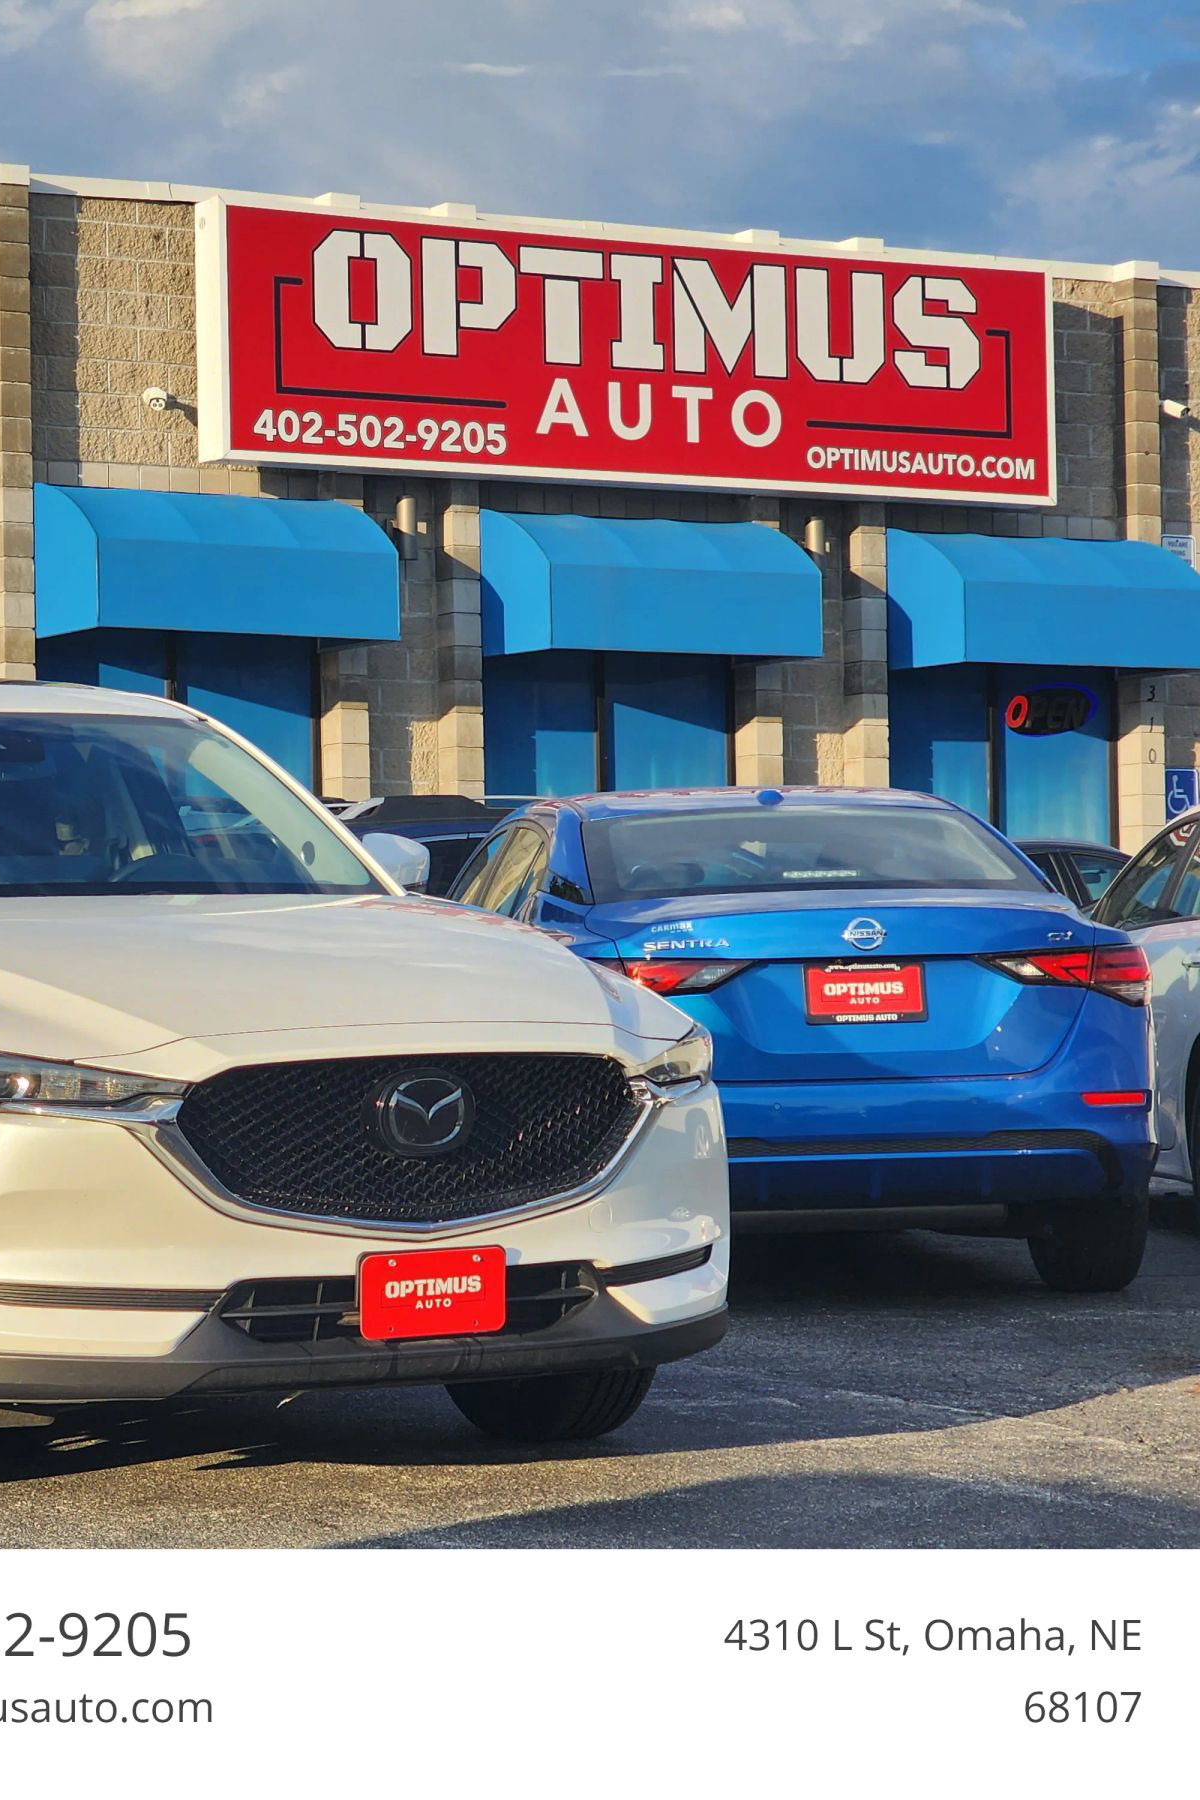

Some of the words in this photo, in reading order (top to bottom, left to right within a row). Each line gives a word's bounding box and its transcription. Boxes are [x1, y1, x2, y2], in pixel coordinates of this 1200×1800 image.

[312, 229, 982, 391] OPTIMUS
[536, 379, 783, 449] AUTO
[253, 408, 507, 455] 402-502-9205
[806, 446, 1035, 480] OPTIMUSAUTO.COM
[1005, 695, 1088, 729] OPEN
[643, 938, 730, 951] SENTRA
[823, 981, 904, 996] OPTIMUS
[849, 997, 880, 1005] AUTO
[836, 1014, 874, 1022] OPTIMUS
[875, 1013, 898, 1021] AUTO
[384, 1275, 482, 1299] OPTIMUS
[415, 1298, 452, 1310] AUTO
